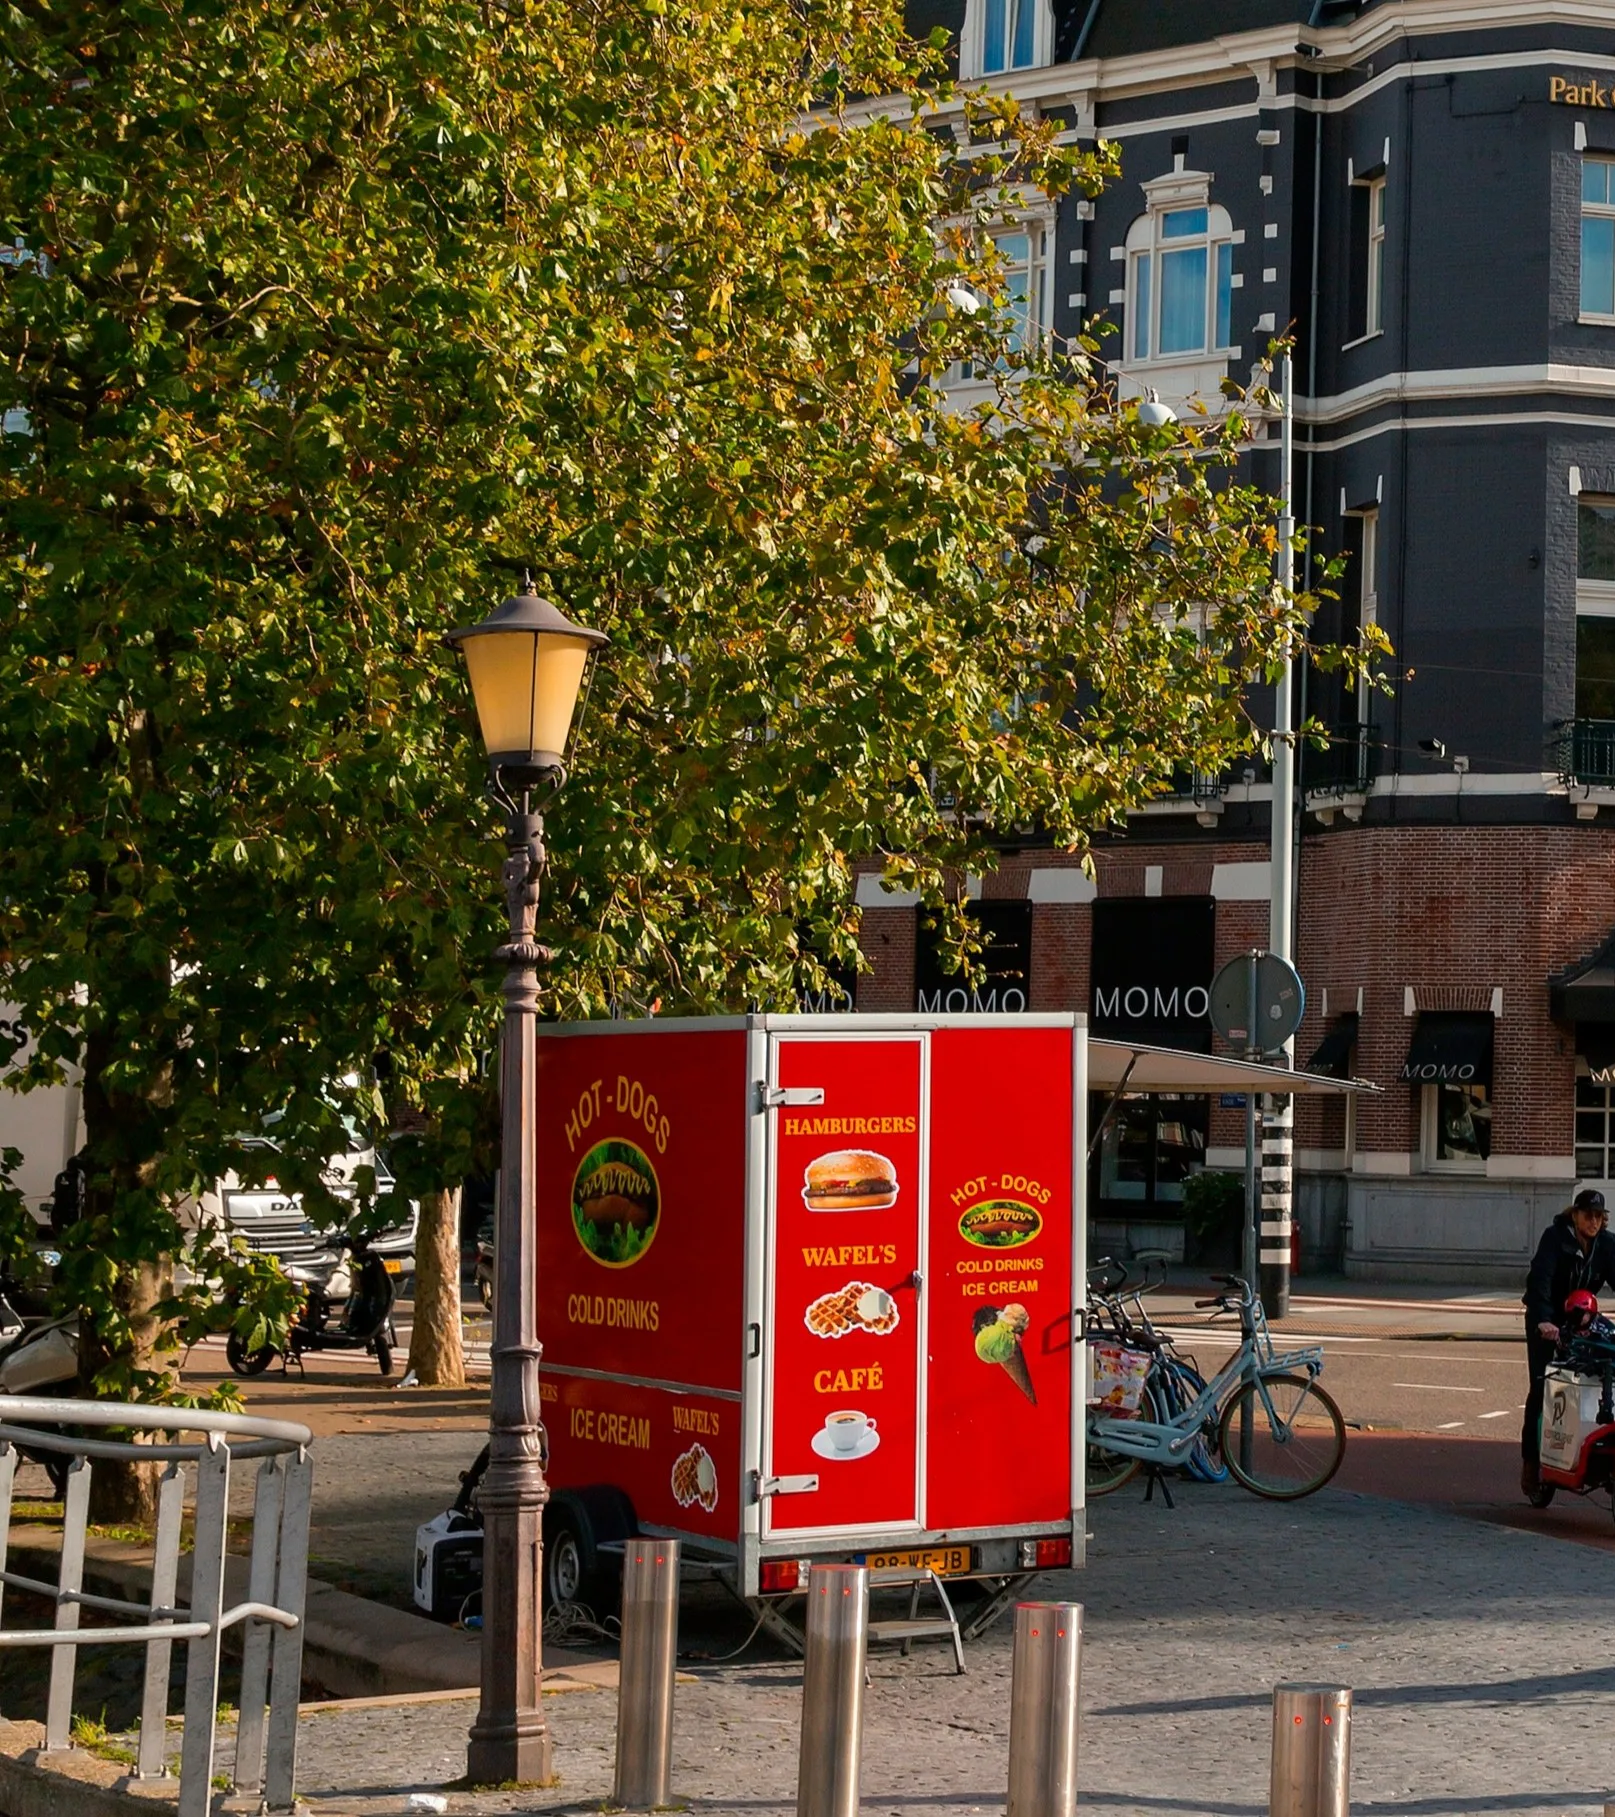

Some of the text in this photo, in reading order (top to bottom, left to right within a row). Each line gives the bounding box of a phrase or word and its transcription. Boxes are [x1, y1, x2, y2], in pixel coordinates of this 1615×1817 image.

[1549, 76, 1607, 108] Park
[918, 988, 1026, 1013] MOMO
[1095, 986, 1209, 1018] MOMO
[1400, 1063, 1475, 1081] MOMO
[784, 1116, 916, 1136] HAMBURGERS
[802, 1244, 897, 1267] WAFEL'S
[956, 1258, 1044, 1274] COLD DRINKS
[962, 1280, 1038, 1296] ICE CREAM
[568, 1294, 659, 1332] COLD DRINKS
[814, 1362, 884, 1393] CAFÉ
[571, 1407, 650, 1449] ICE CREAM
[673, 1406, 719, 1436] WAFEL'S
